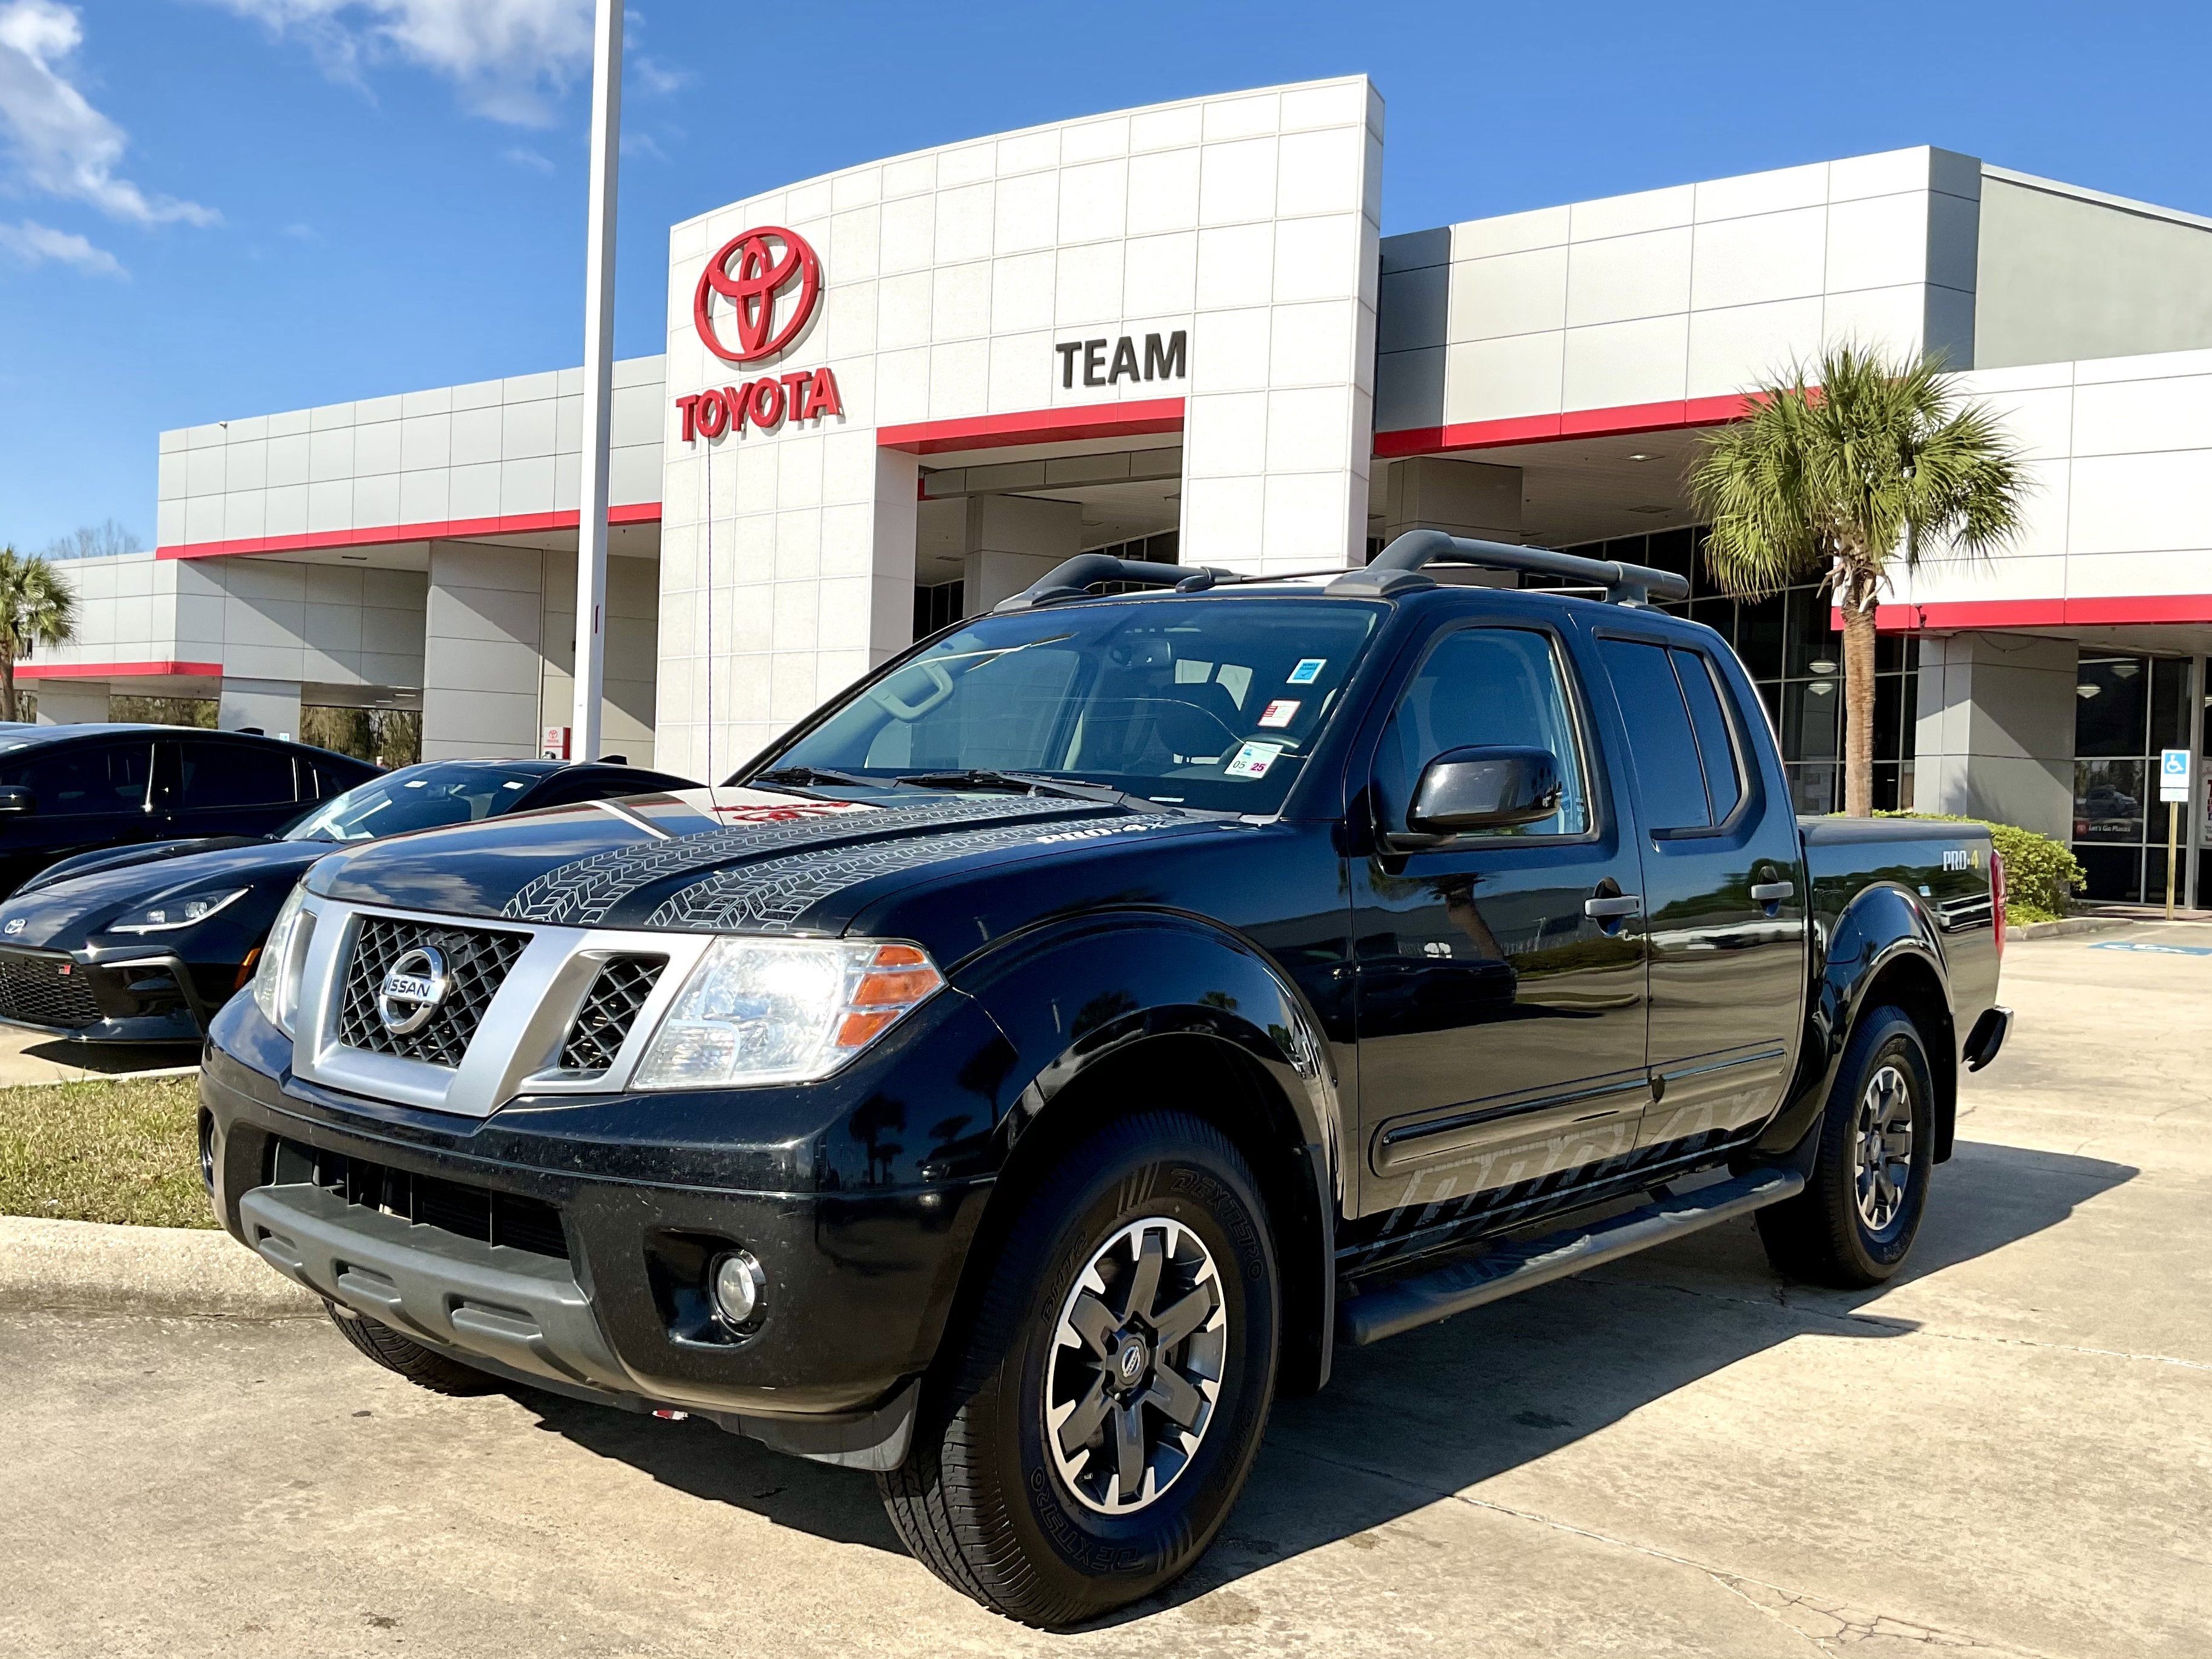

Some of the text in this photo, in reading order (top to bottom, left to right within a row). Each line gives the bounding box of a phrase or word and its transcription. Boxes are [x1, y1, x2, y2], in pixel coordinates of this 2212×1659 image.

[1055, 330, 1187, 388] TEAM
[676, 367, 842, 442] TOYOTA
[1232, 761, 1266, 771] 05 25
[383, 978, 431, 997] NISSAN
